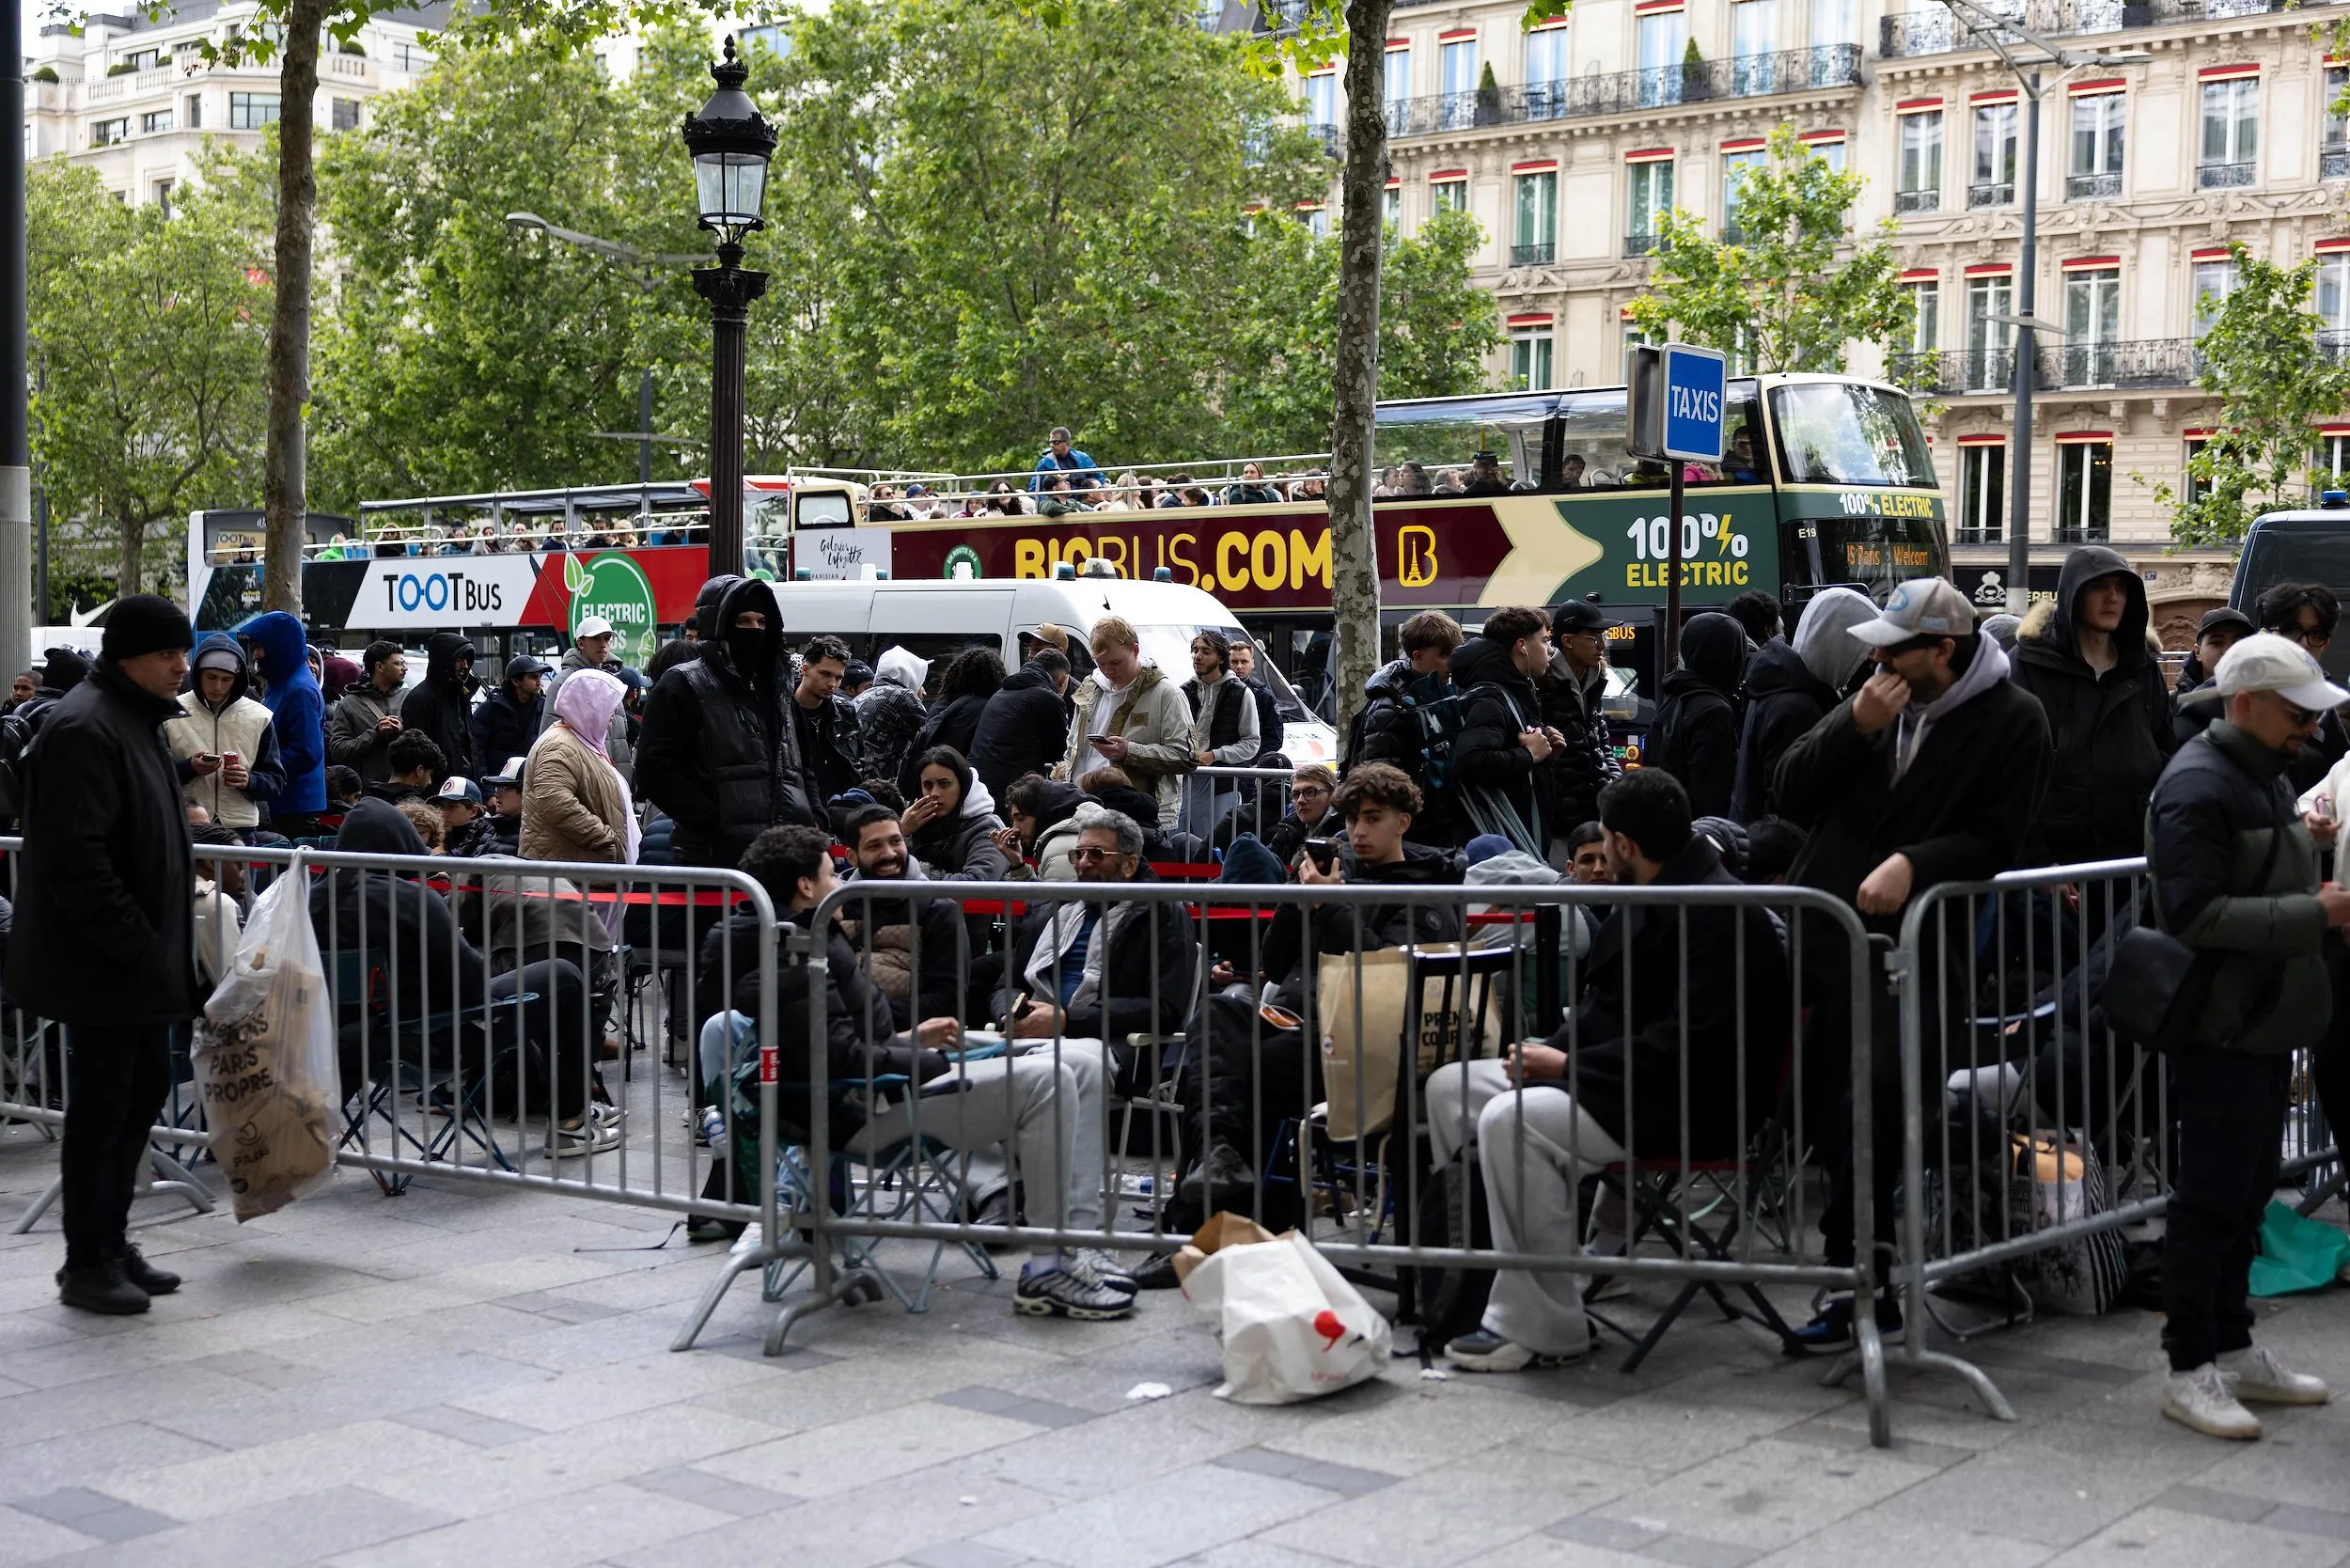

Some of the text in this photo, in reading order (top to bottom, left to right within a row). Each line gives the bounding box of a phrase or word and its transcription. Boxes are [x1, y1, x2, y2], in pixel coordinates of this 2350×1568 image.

[1671, 385, 1718, 423] TAXIS
[1839, 493, 1934, 518] 100% ELECTRIC
[1798, 528, 1817, 539] E19
[1626, 513, 1748, 588] 100% ELECTRIC
[1857, 542, 1881, 566] Paris
[209, 1045, 258, 1076] PARIS
[205, 1068, 274, 1104] PROPRE
